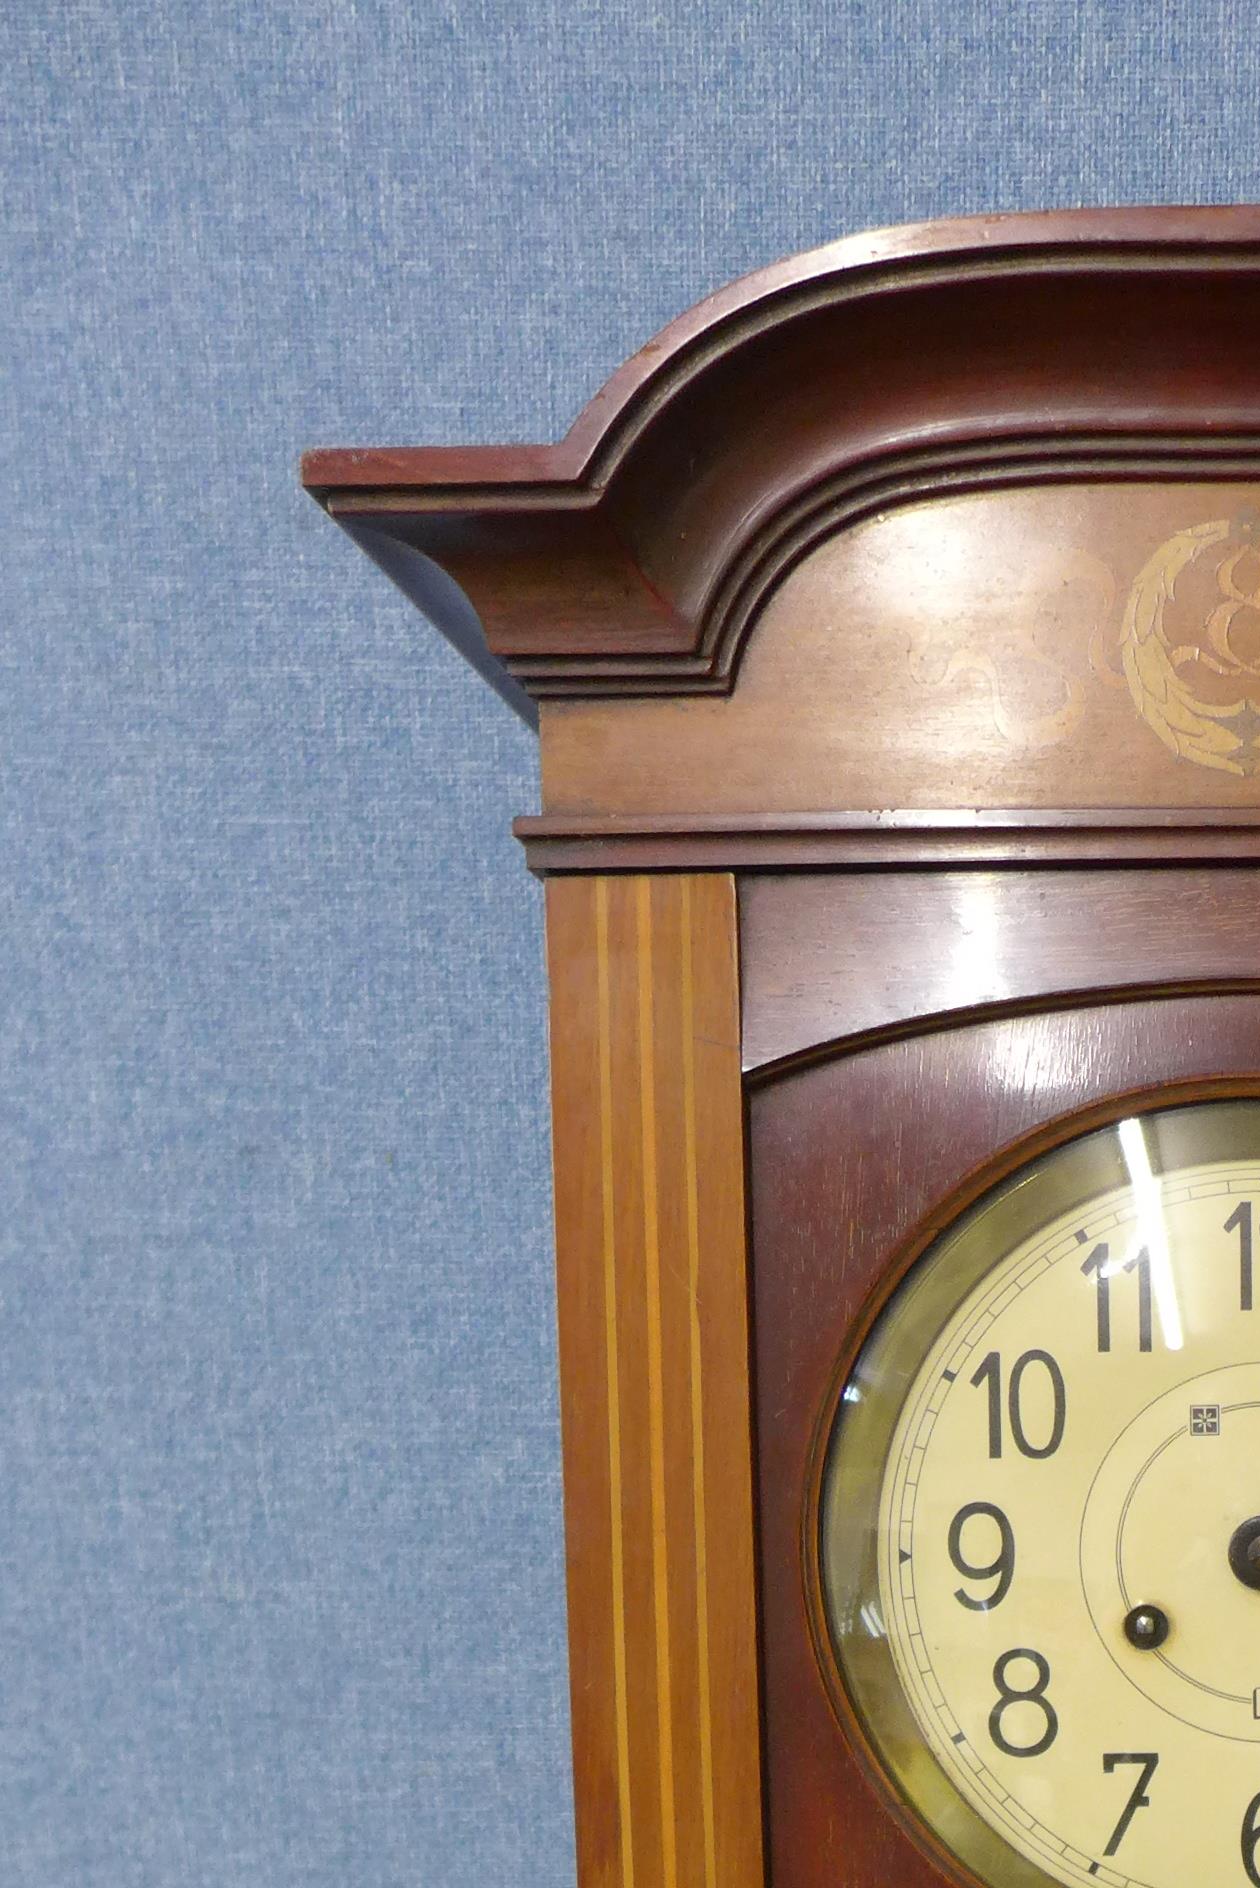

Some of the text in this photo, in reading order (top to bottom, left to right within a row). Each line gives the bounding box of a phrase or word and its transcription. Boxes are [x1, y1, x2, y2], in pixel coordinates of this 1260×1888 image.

[1080, 1241, 1153, 1353] 11
[969, 1348, 1067, 1460] 10
[947, 1501, 1016, 1611] 9
[987, 1647, 1059, 1759] 8
[1102, 1752, 1159, 1857] 7
